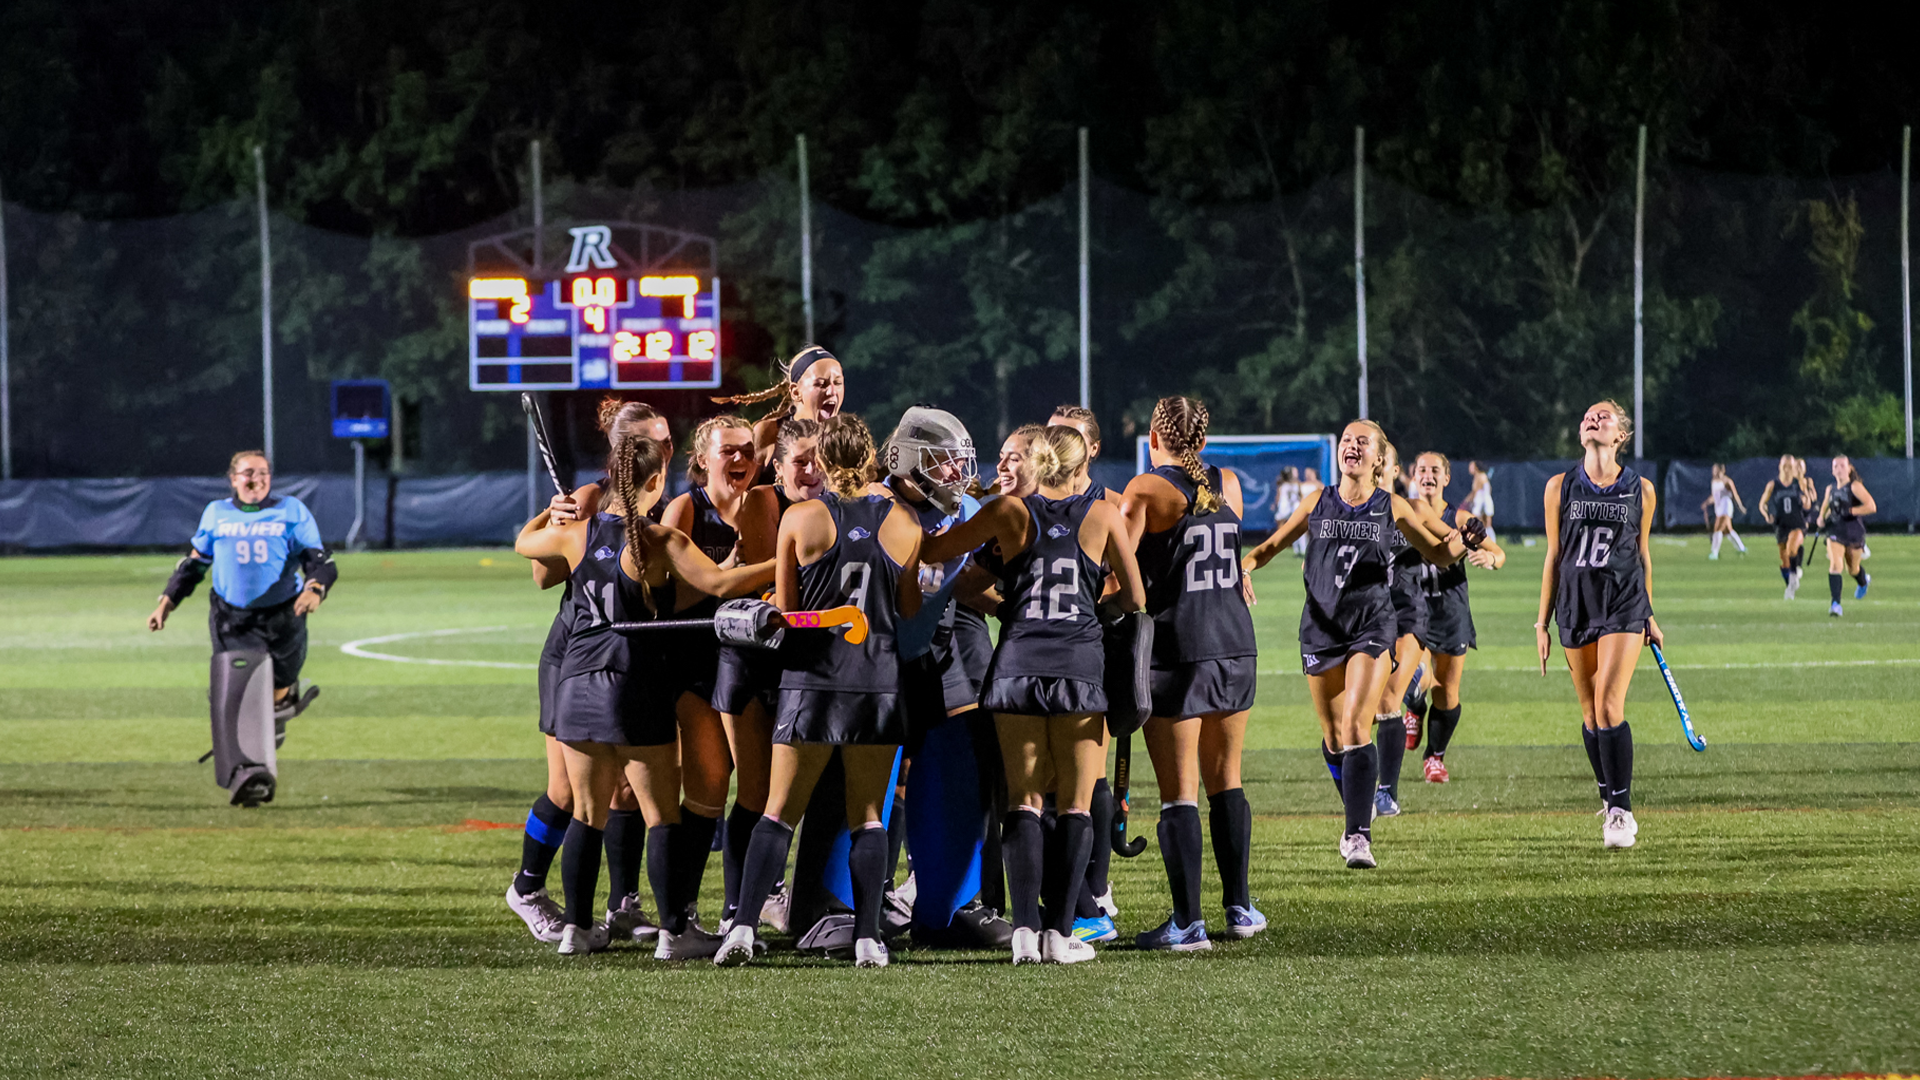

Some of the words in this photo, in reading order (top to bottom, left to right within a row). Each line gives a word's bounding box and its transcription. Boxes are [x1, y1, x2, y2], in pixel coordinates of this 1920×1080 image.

[564, 225, 618, 273] R
[584, 307, 605, 332] 4
[218, 521, 286, 536] RIVIER
[1320, 519, 1380, 542] RIVIER
[1569, 500, 1628, 523] RIVIER
[236, 539, 268, 564] 99
[1184, 523, 1238, 592] 25
[1335, 545, 1358, 588] 3
[1575, 526, 1613, 567] 16
[583, 580, 614, 627] 11
[1025, 557, 1080, 621] 12
